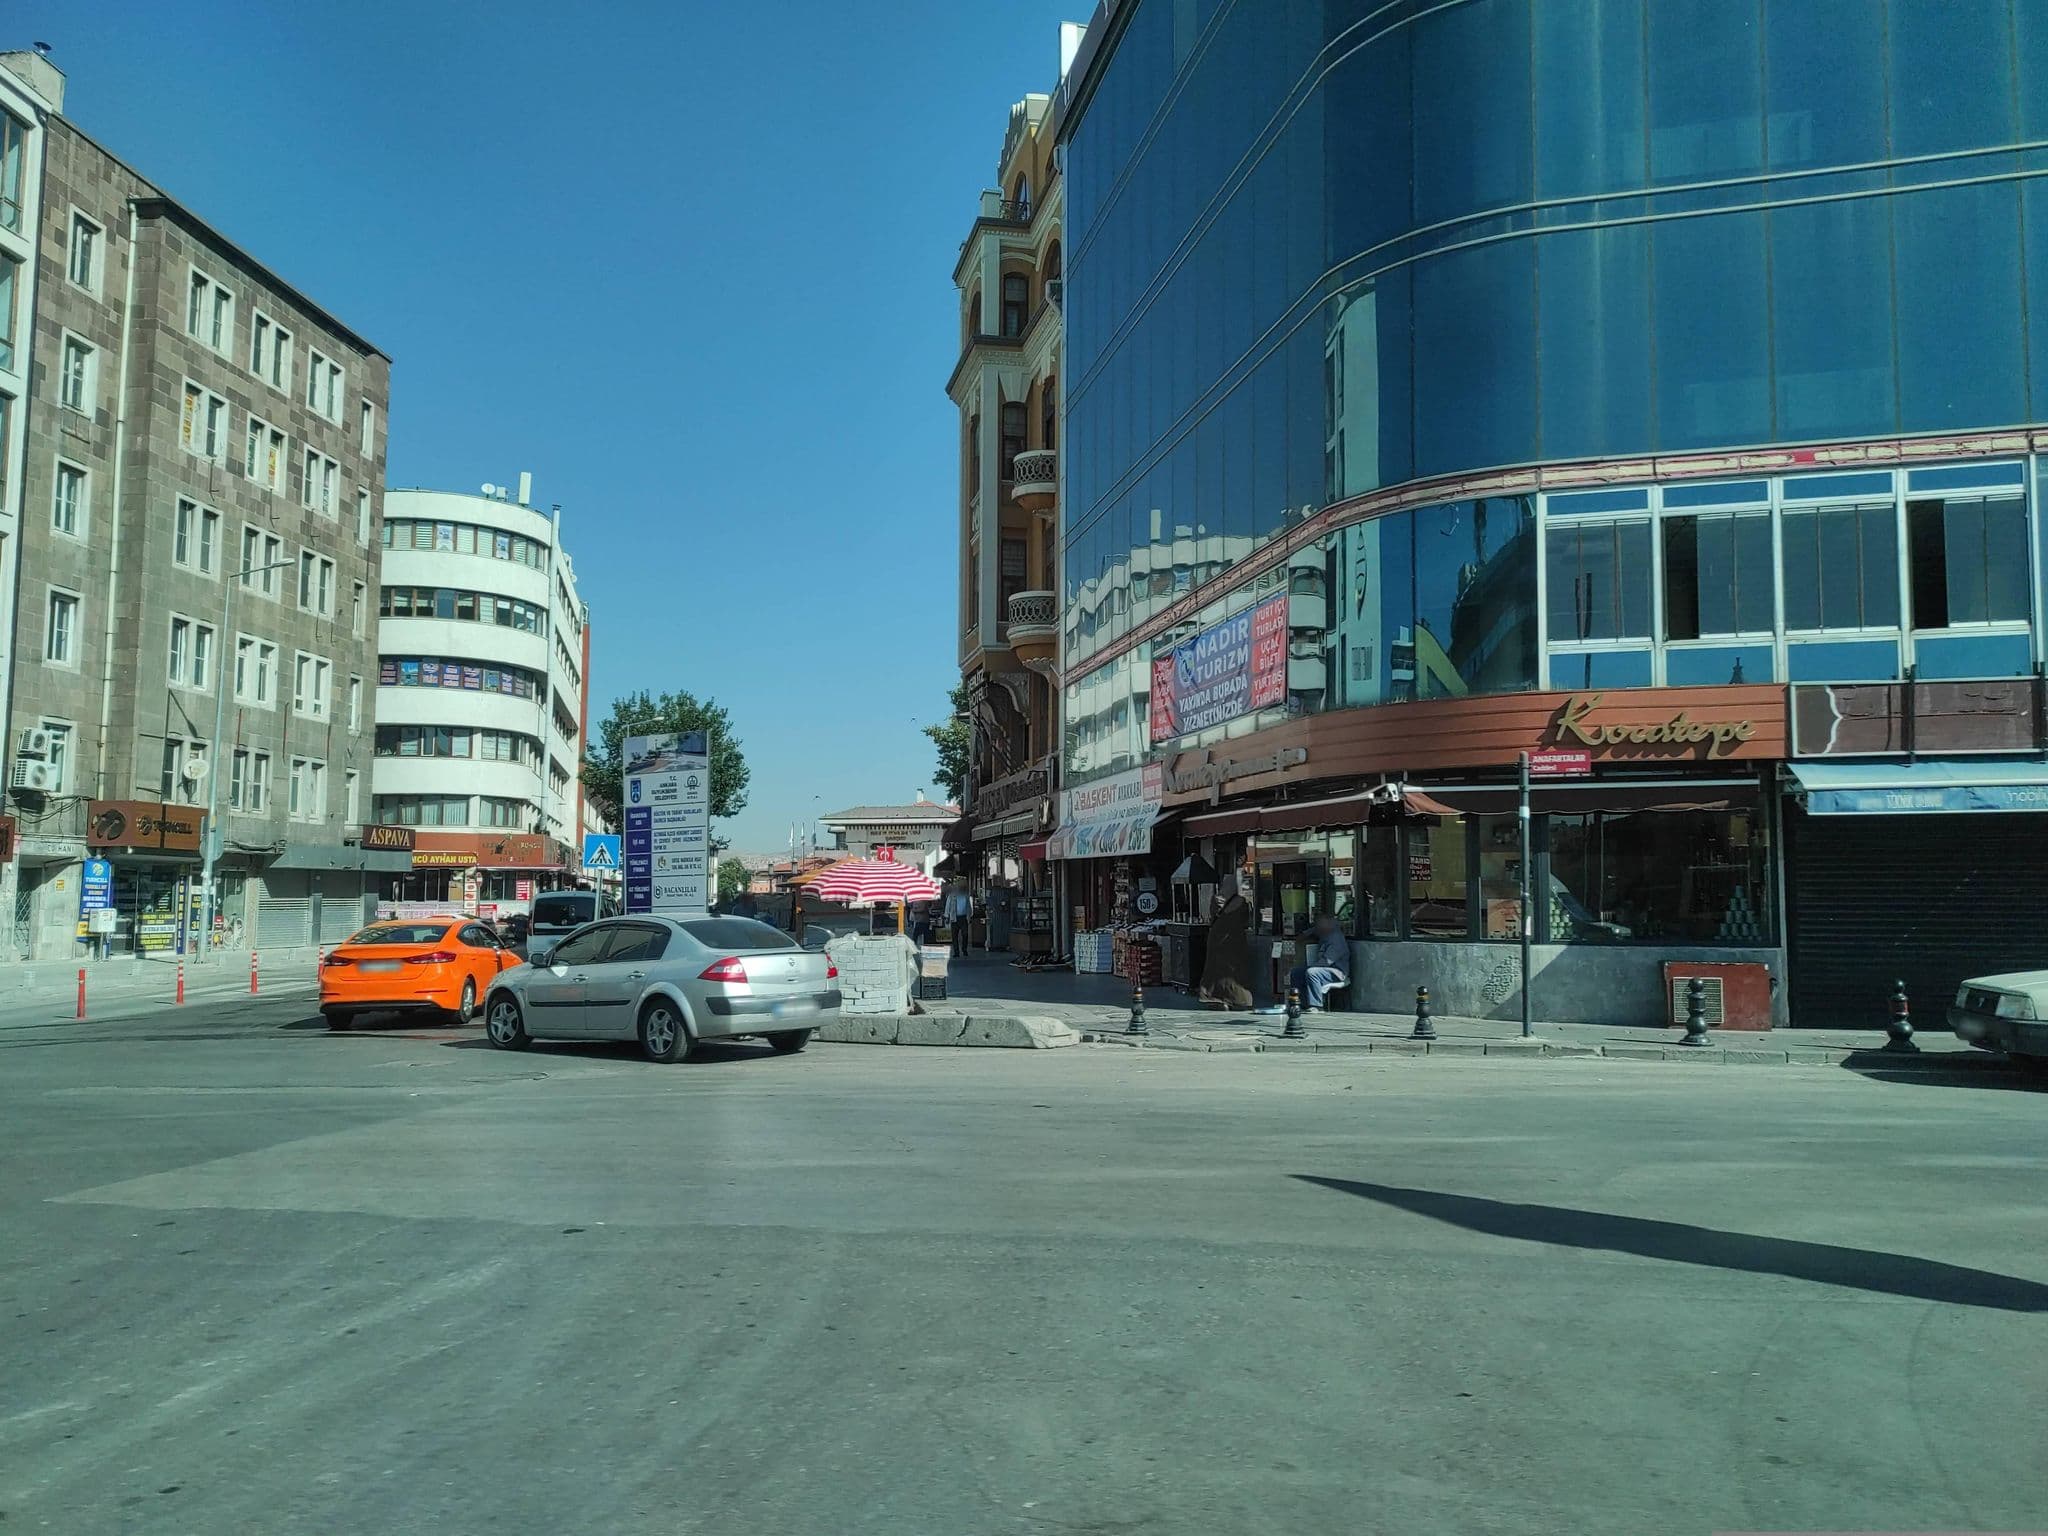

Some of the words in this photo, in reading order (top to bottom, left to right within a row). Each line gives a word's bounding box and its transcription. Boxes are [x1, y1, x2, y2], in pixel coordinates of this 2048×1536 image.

[1196, 643, 1249, 684] TURİZM
[1213, 672, 1248, 702] BURADA
[1556, 694, 1756, 760] Kocatepe
[1532, 754, 1586, 762] ANAFARTALAR
[153, 820, 192, 834] TURKCELL
[369, 826, 410, 847] ASPAVA
[429, 854, 457, 864] AYHAN
[458, 854, 477, 864] USTA
